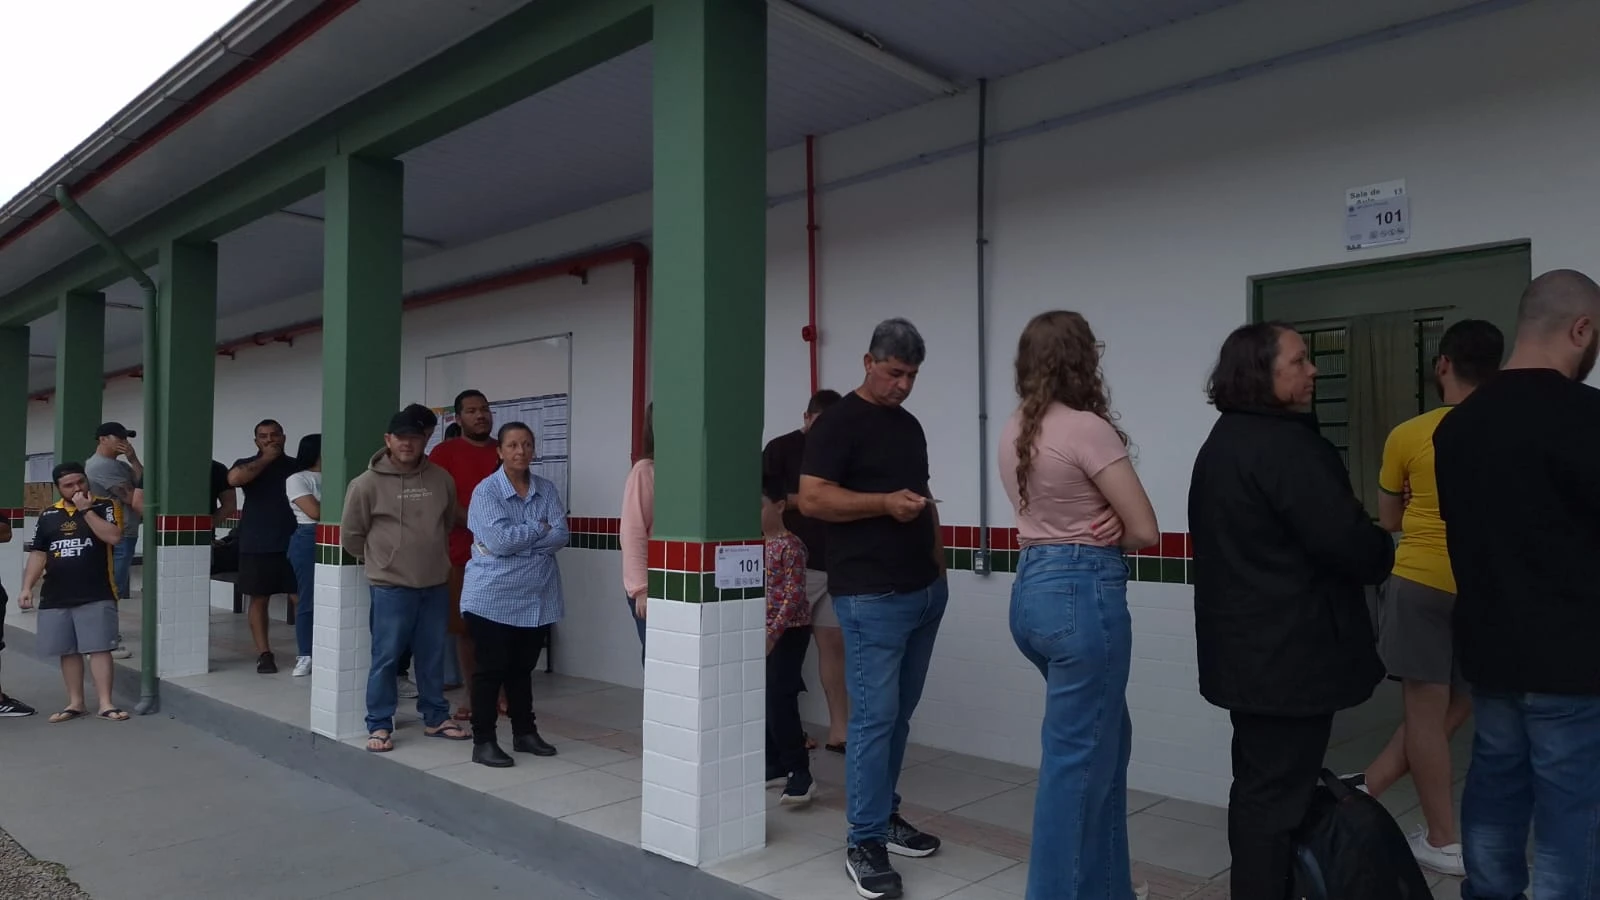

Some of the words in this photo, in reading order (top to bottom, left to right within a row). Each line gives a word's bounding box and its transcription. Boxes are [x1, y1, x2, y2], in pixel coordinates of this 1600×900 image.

[1350, 191, 1368, 199] Sala
[1376, 209, 1402, 226] 101
[60, 547, 84, 557] BET
[739, 560, 759, 572] 101
